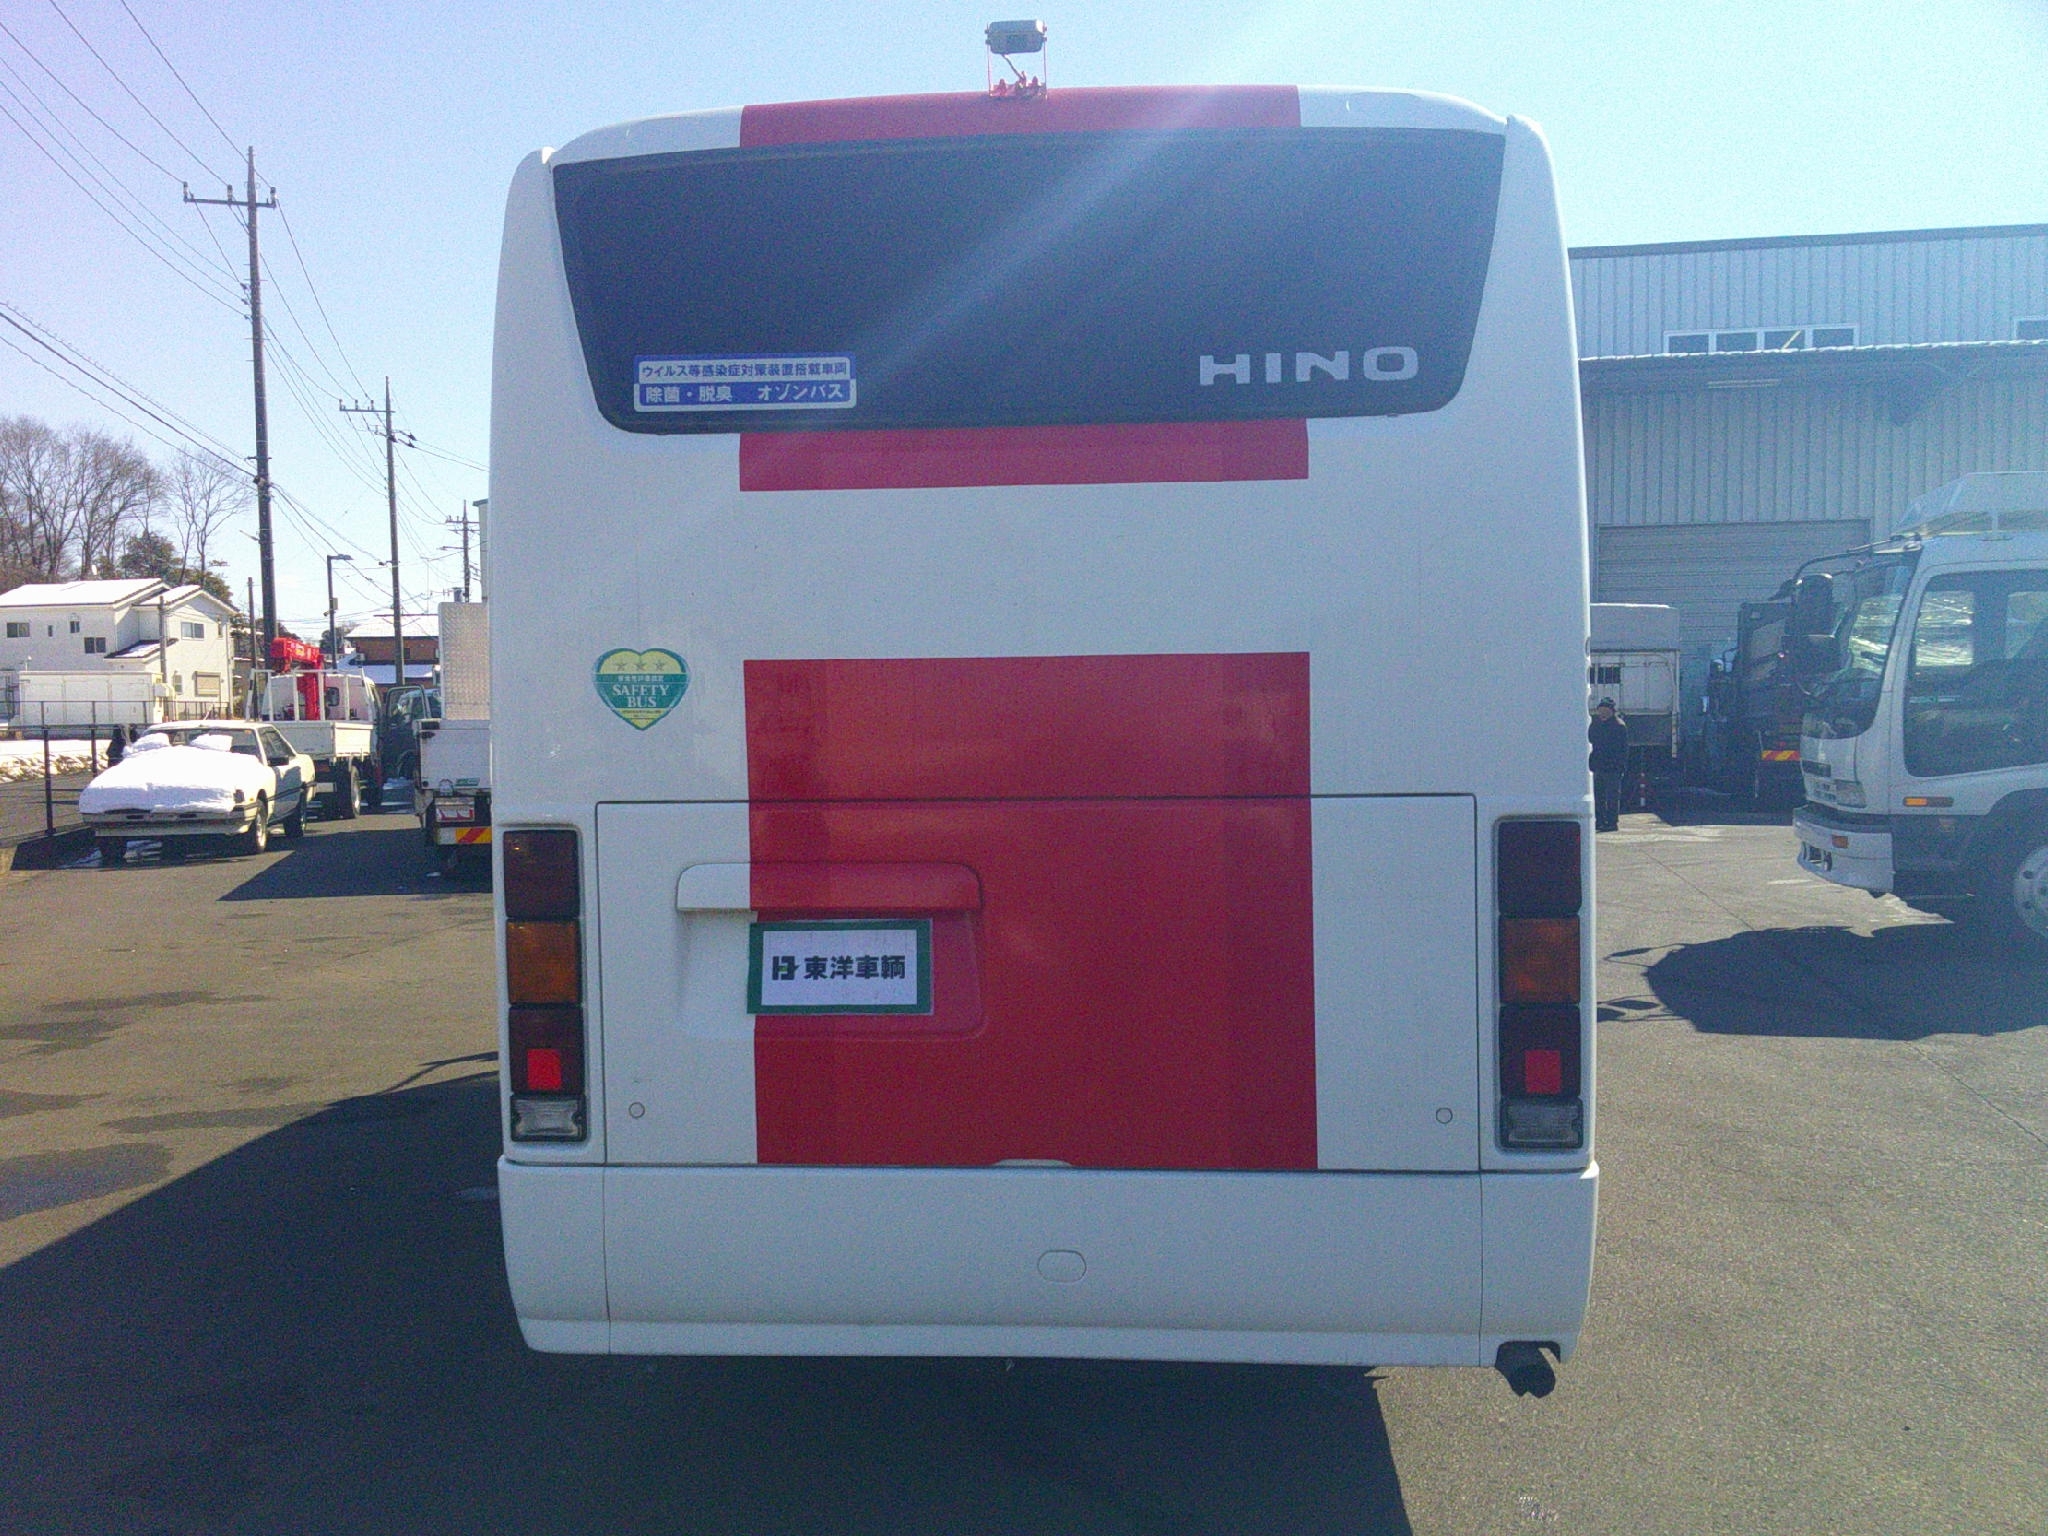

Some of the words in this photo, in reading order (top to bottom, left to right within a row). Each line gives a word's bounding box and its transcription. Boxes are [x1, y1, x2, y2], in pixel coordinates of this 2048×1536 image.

[1199, 346, 1419, 386] HINO
[757, 383, 844, 401] オゾンバス
[612, 684, 670, 696] SAFETY
[627, 696, 658, 708] BUS
